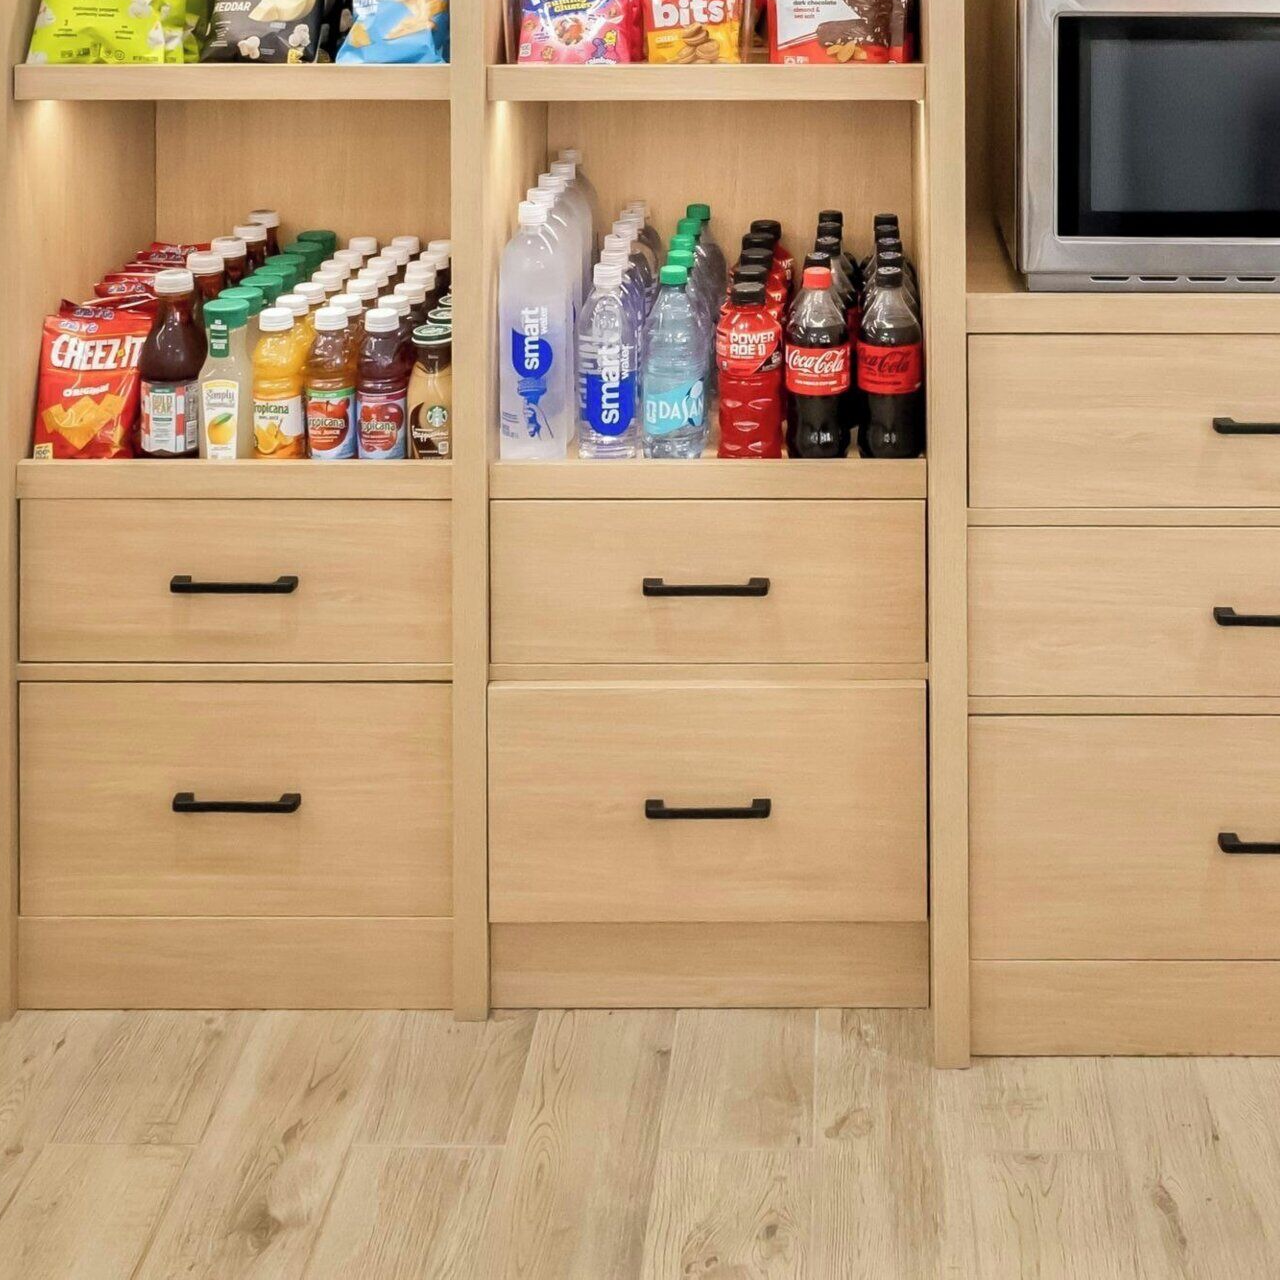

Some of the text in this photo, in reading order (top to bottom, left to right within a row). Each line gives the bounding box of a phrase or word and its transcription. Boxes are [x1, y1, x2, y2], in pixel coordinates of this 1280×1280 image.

[522, 307, 539, 370] smart
[730, 332, 775, 345] POWER
[621, 342, 634, 380] water
[788, 348, 845, 374] Coca-Cola
[206, 389, 234, 402] Simply
[599, 345, 620, 424] smart
